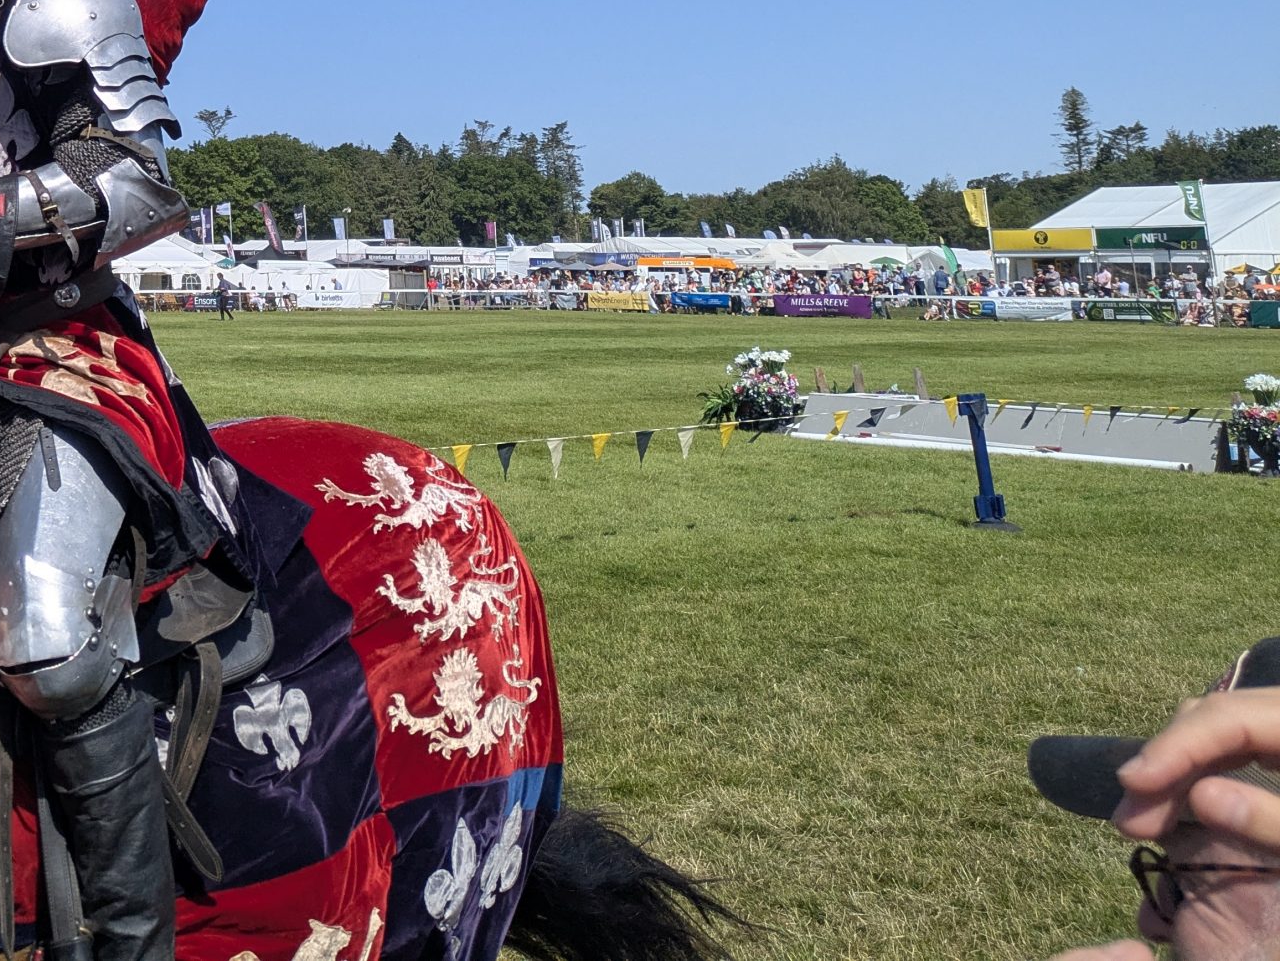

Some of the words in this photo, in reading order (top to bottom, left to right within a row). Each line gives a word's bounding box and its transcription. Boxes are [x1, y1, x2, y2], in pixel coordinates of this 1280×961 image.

[1184, 185, 1198, 210] NFU
[1141, 233, 1167, 243] NFU
[815, 298, 822, 306] &
[823, 299, 848, 307] REEVE
